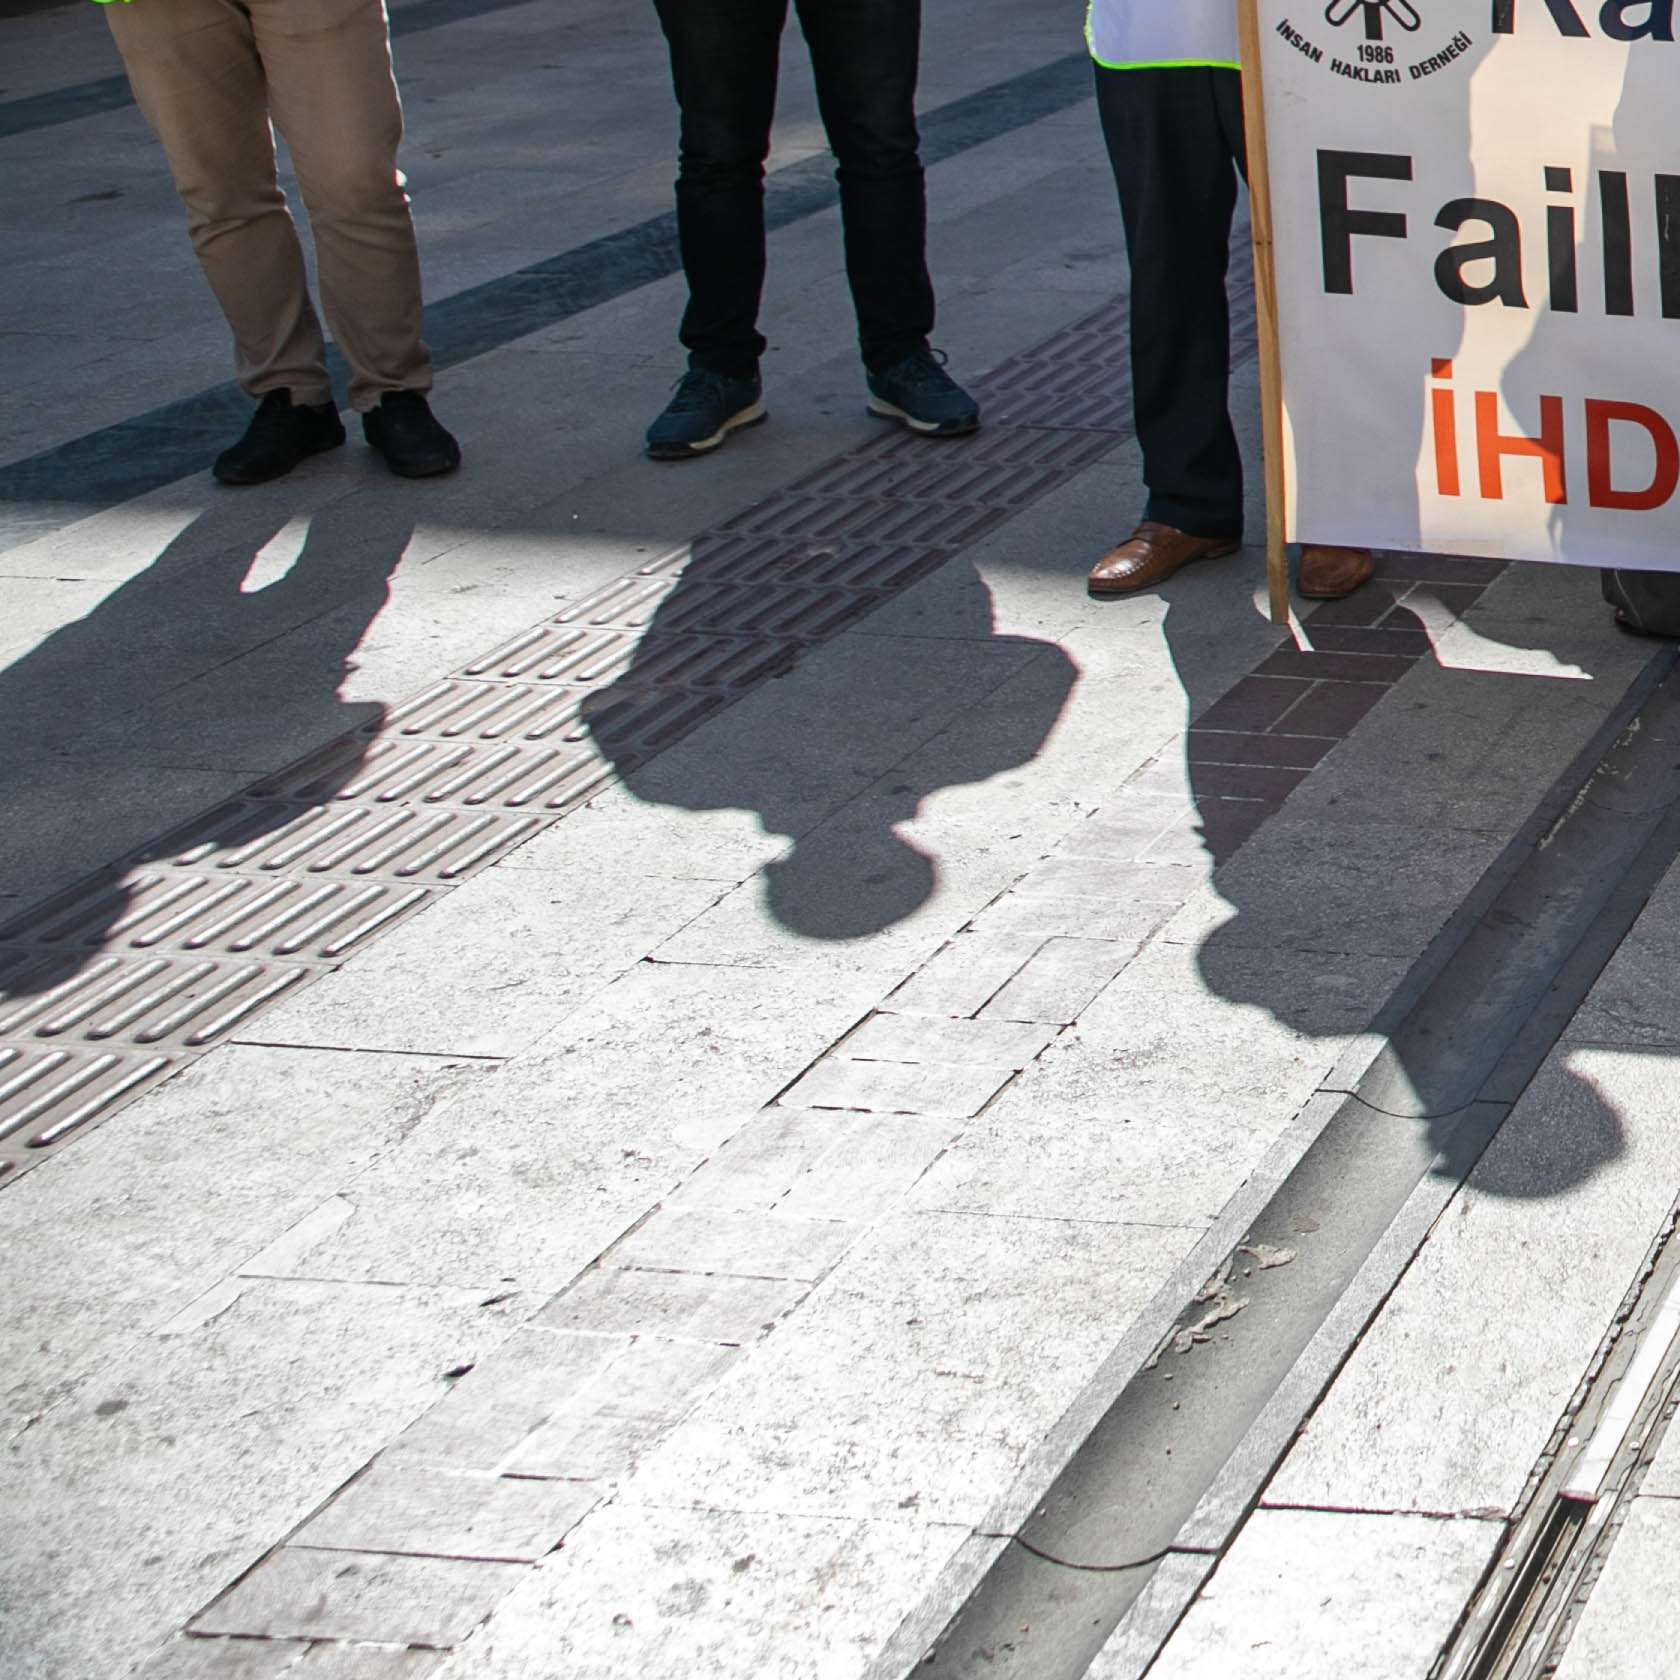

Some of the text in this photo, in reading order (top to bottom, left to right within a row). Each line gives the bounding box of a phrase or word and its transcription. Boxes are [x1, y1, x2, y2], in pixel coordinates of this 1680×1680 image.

[1275, 18, 1474, 84] İNSAN HAKLARI DERNEĞİ
[1356, 44, 1395, 65] 1986
[1430, 357, 1680, 510] İHD
